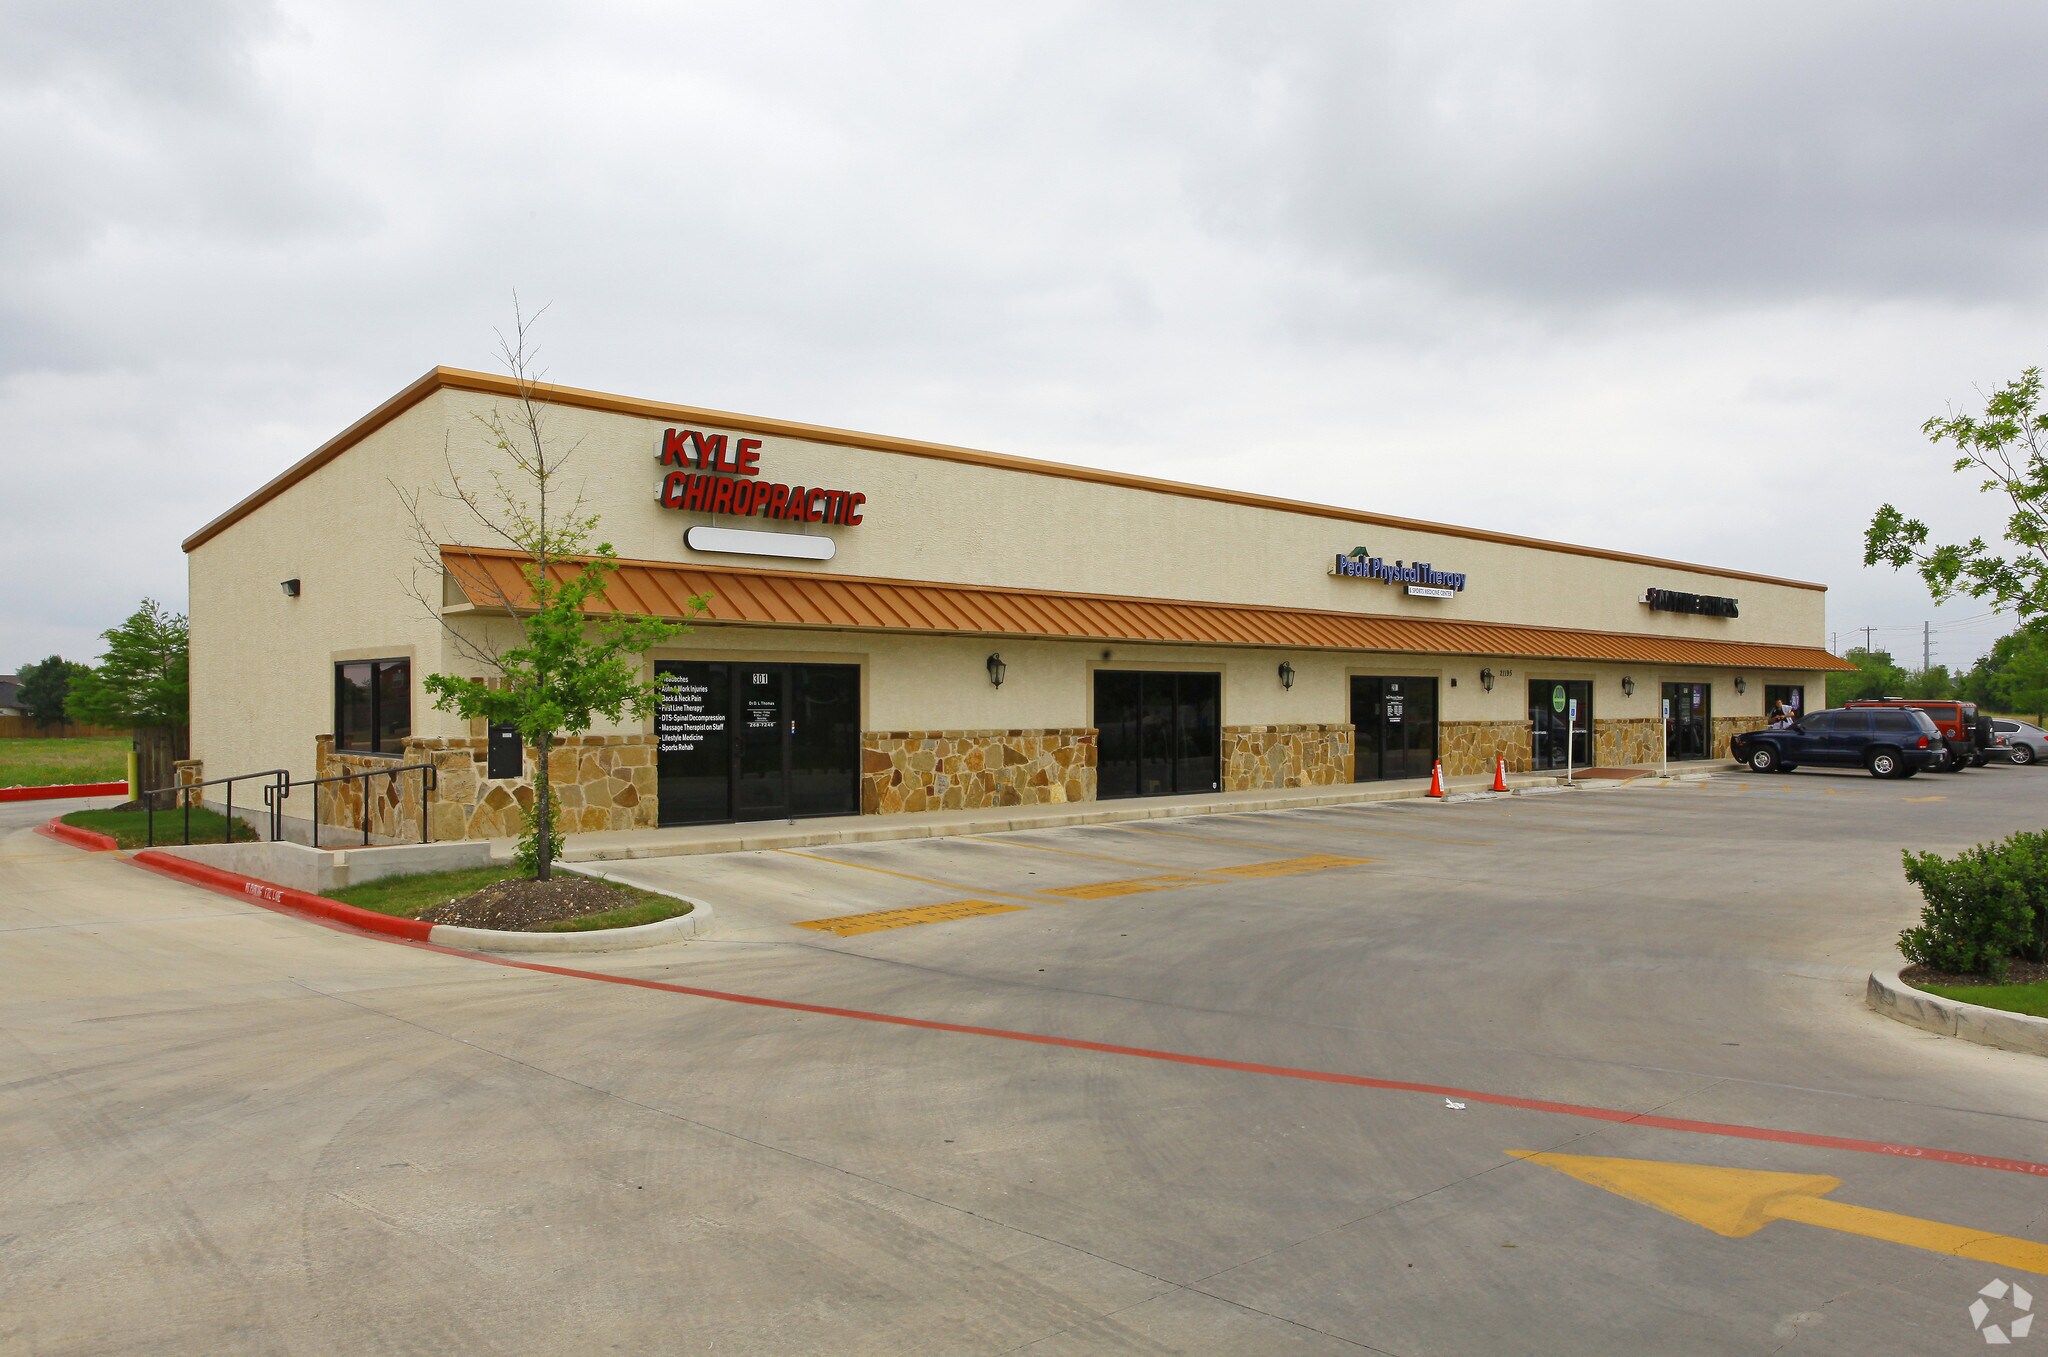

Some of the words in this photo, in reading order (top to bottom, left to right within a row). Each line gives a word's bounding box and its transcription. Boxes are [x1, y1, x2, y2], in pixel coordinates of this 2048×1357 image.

[660, 428, 762, 476] KYLE
[661, 471, 867, 527] CHIROPRACTIC
[1338, 553, 1371, 578] Peak
[1371, 557, 1420, 585] Physical
[1421, 562, 1466, 591] Therapy
[753, 673, 768, 684] 301
[690, 685, 708, 693] Injuries
[662, 694, 674, 702] Back
[678, 694, 691, 702] Neck
[691, 694, 702, 702] Pain
[672, 704, 683, 712] Line
[689, 713, 726, 722] Decompression
[662, 723, 683, 732] Massage
[683, 723, 706, 732] Therapist
[712, 723, 724, 731] Staff
[662, 733, 682, 742] Lifestyle
[682, 733, 704, 741] Medicine
[662, 743, 678, 752] Sports
[678, 743, 694, 751] Rehab
